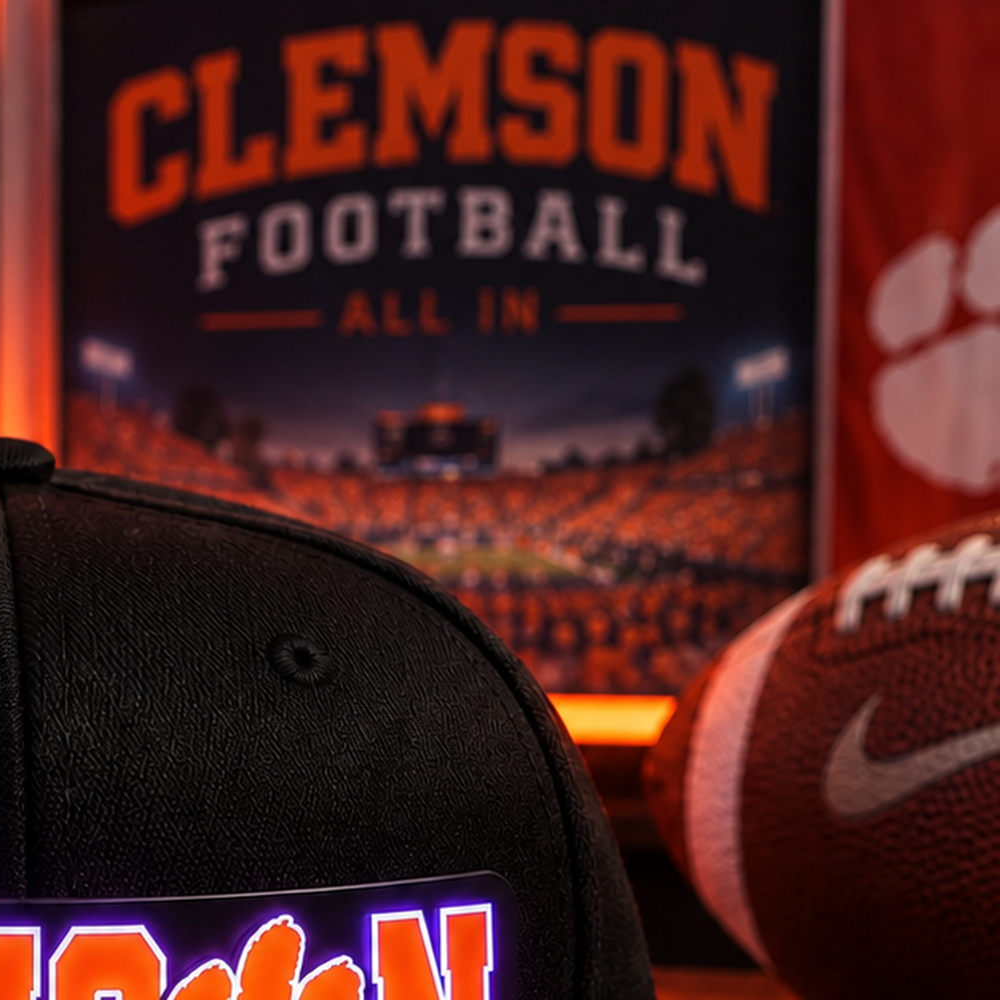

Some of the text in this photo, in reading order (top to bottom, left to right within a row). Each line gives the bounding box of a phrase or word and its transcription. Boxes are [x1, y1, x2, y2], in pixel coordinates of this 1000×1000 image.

[107, 19, 778, 229] CLEMSON
[196, 185, 706, 292] FOOTBALL
[338, 286, 541, 338] ALL IN
